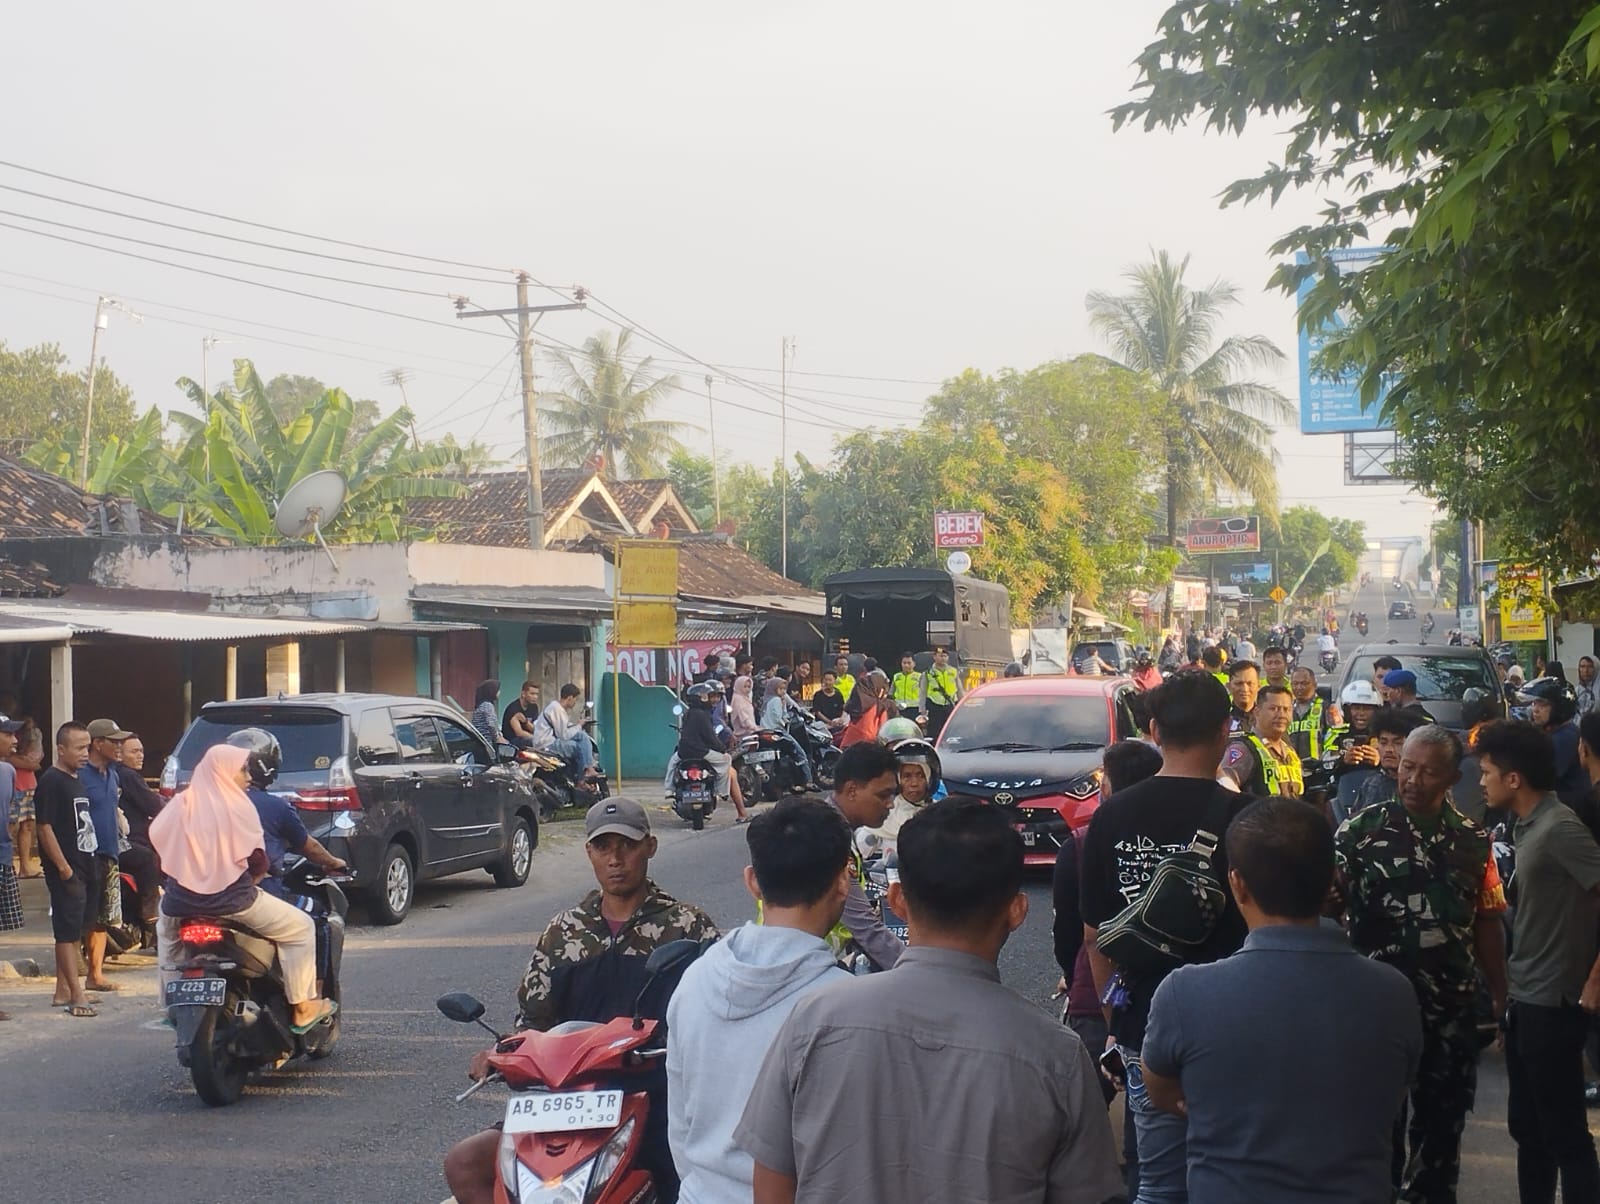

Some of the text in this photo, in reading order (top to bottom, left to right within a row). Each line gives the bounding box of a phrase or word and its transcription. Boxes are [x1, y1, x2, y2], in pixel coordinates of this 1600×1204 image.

[938, 516, 983, 534] BEBEK
[1192, 533, 1248, 545] AKUR OPTIC
[968, 778, 1043, 789] CALYA
[511, 1094, 617, 1115] AB 6965 TR
